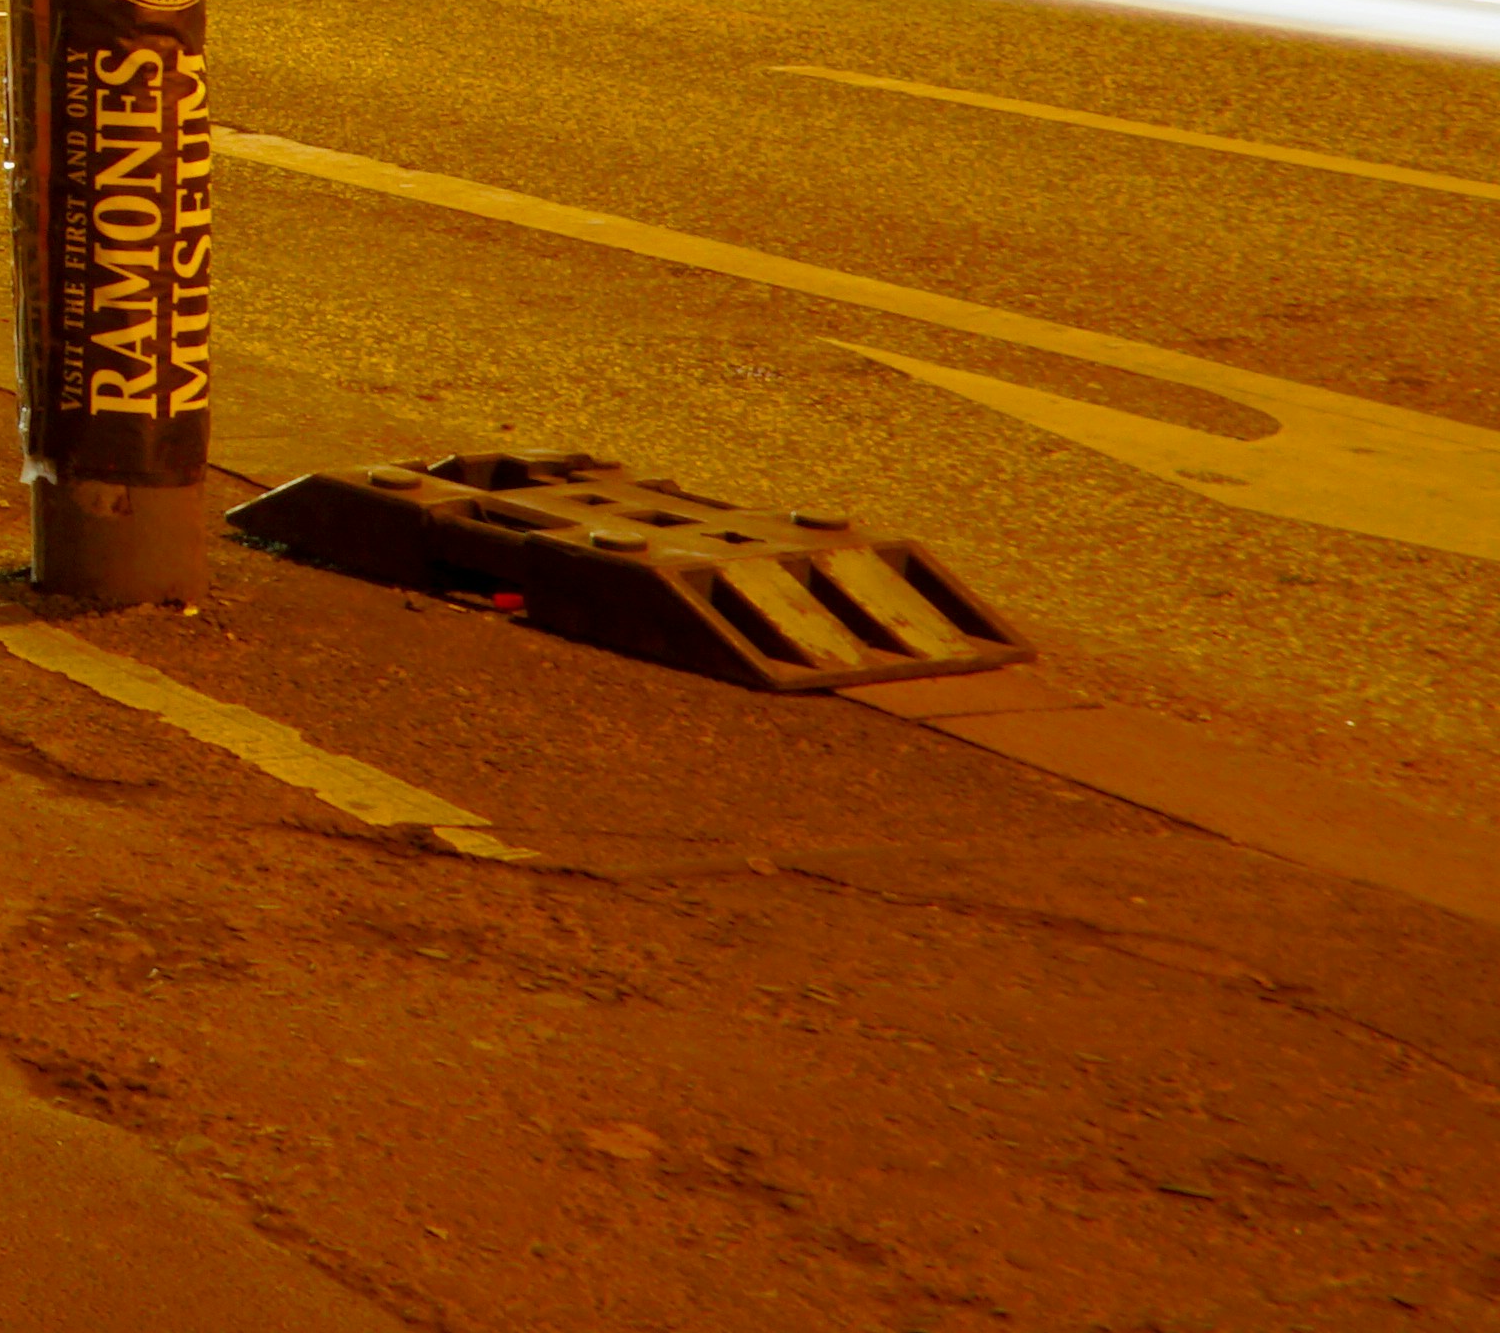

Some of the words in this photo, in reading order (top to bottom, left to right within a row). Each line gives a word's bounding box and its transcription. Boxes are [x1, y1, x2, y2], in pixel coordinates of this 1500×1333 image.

[66, 45, 90, 119] ONLY
[66, 134, 90, 186] AND
[63, 196, 89, 272] FIRST
[90, 47, 164, 420] RAMONES
[169, 49, 212, 420] MUSEUM
[62, 274, 87, 332] THE
[60, 344, 87, 412] VISIT
